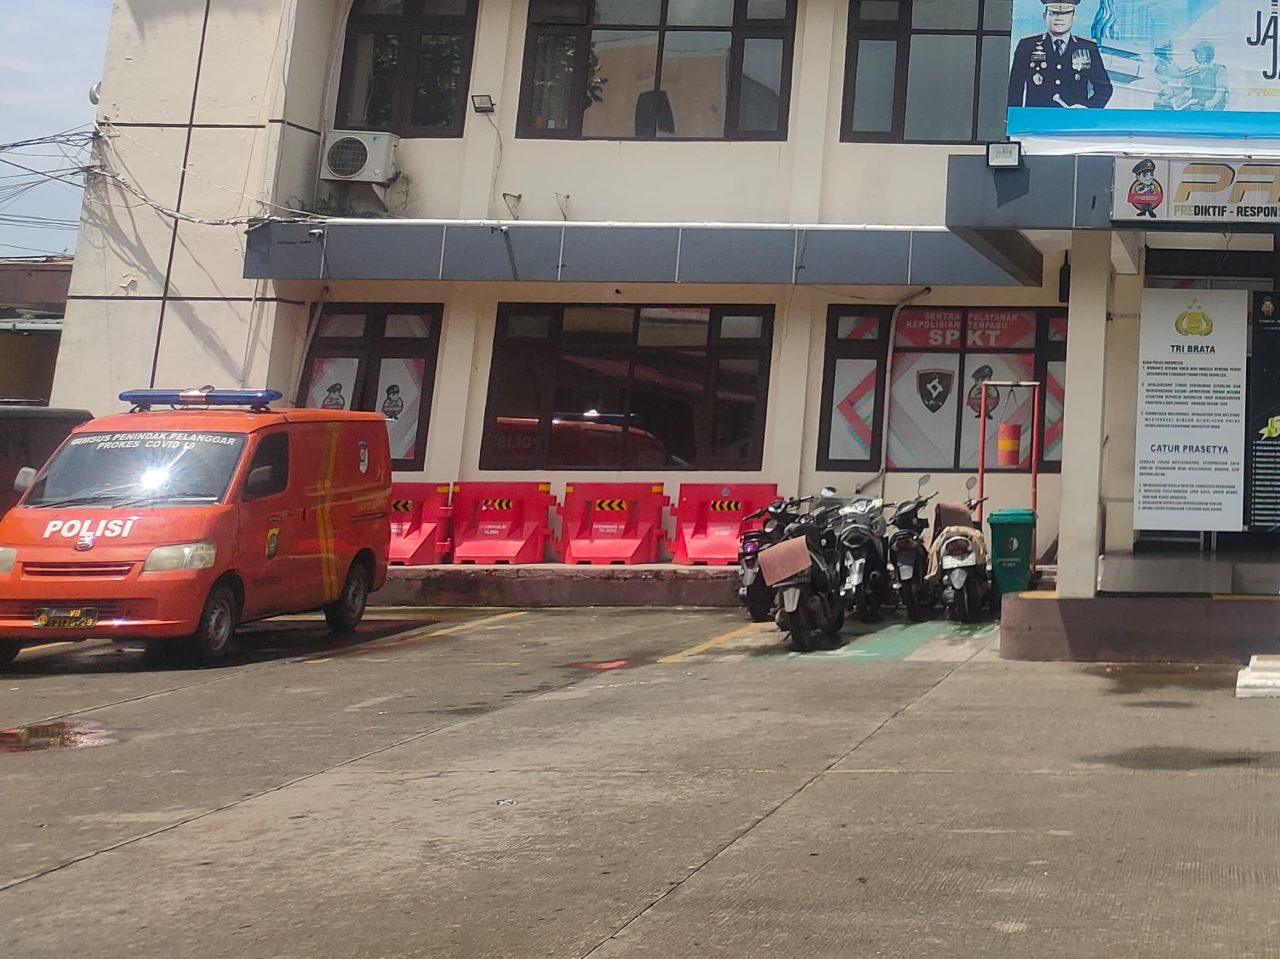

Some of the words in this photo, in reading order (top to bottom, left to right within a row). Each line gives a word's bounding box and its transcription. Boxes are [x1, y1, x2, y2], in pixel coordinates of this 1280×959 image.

[1174, 204, 1228, 218] PREDIKTIF
[967, 312, 1018, 321] PELAYANAN
[906, 321, 960, 329] KEPOLISIAN
[929, 330, 1001, 346] SPKT
[1170, 344, 1185, 353] TRI
[1187, 344, 1216, 354] BRATA
[112, 432, 168, 442] PENINDAK
[168, 432, 236, 446] PELANGGAR
[96, 440, 142, 450] PROKES
[145, 440, 181, 449] COVID
[1150, 444, 1180, 453] CATUR
[1182, 445, 1229, 454] PRASETYA
[42, 519, 134, 538] POLISI
